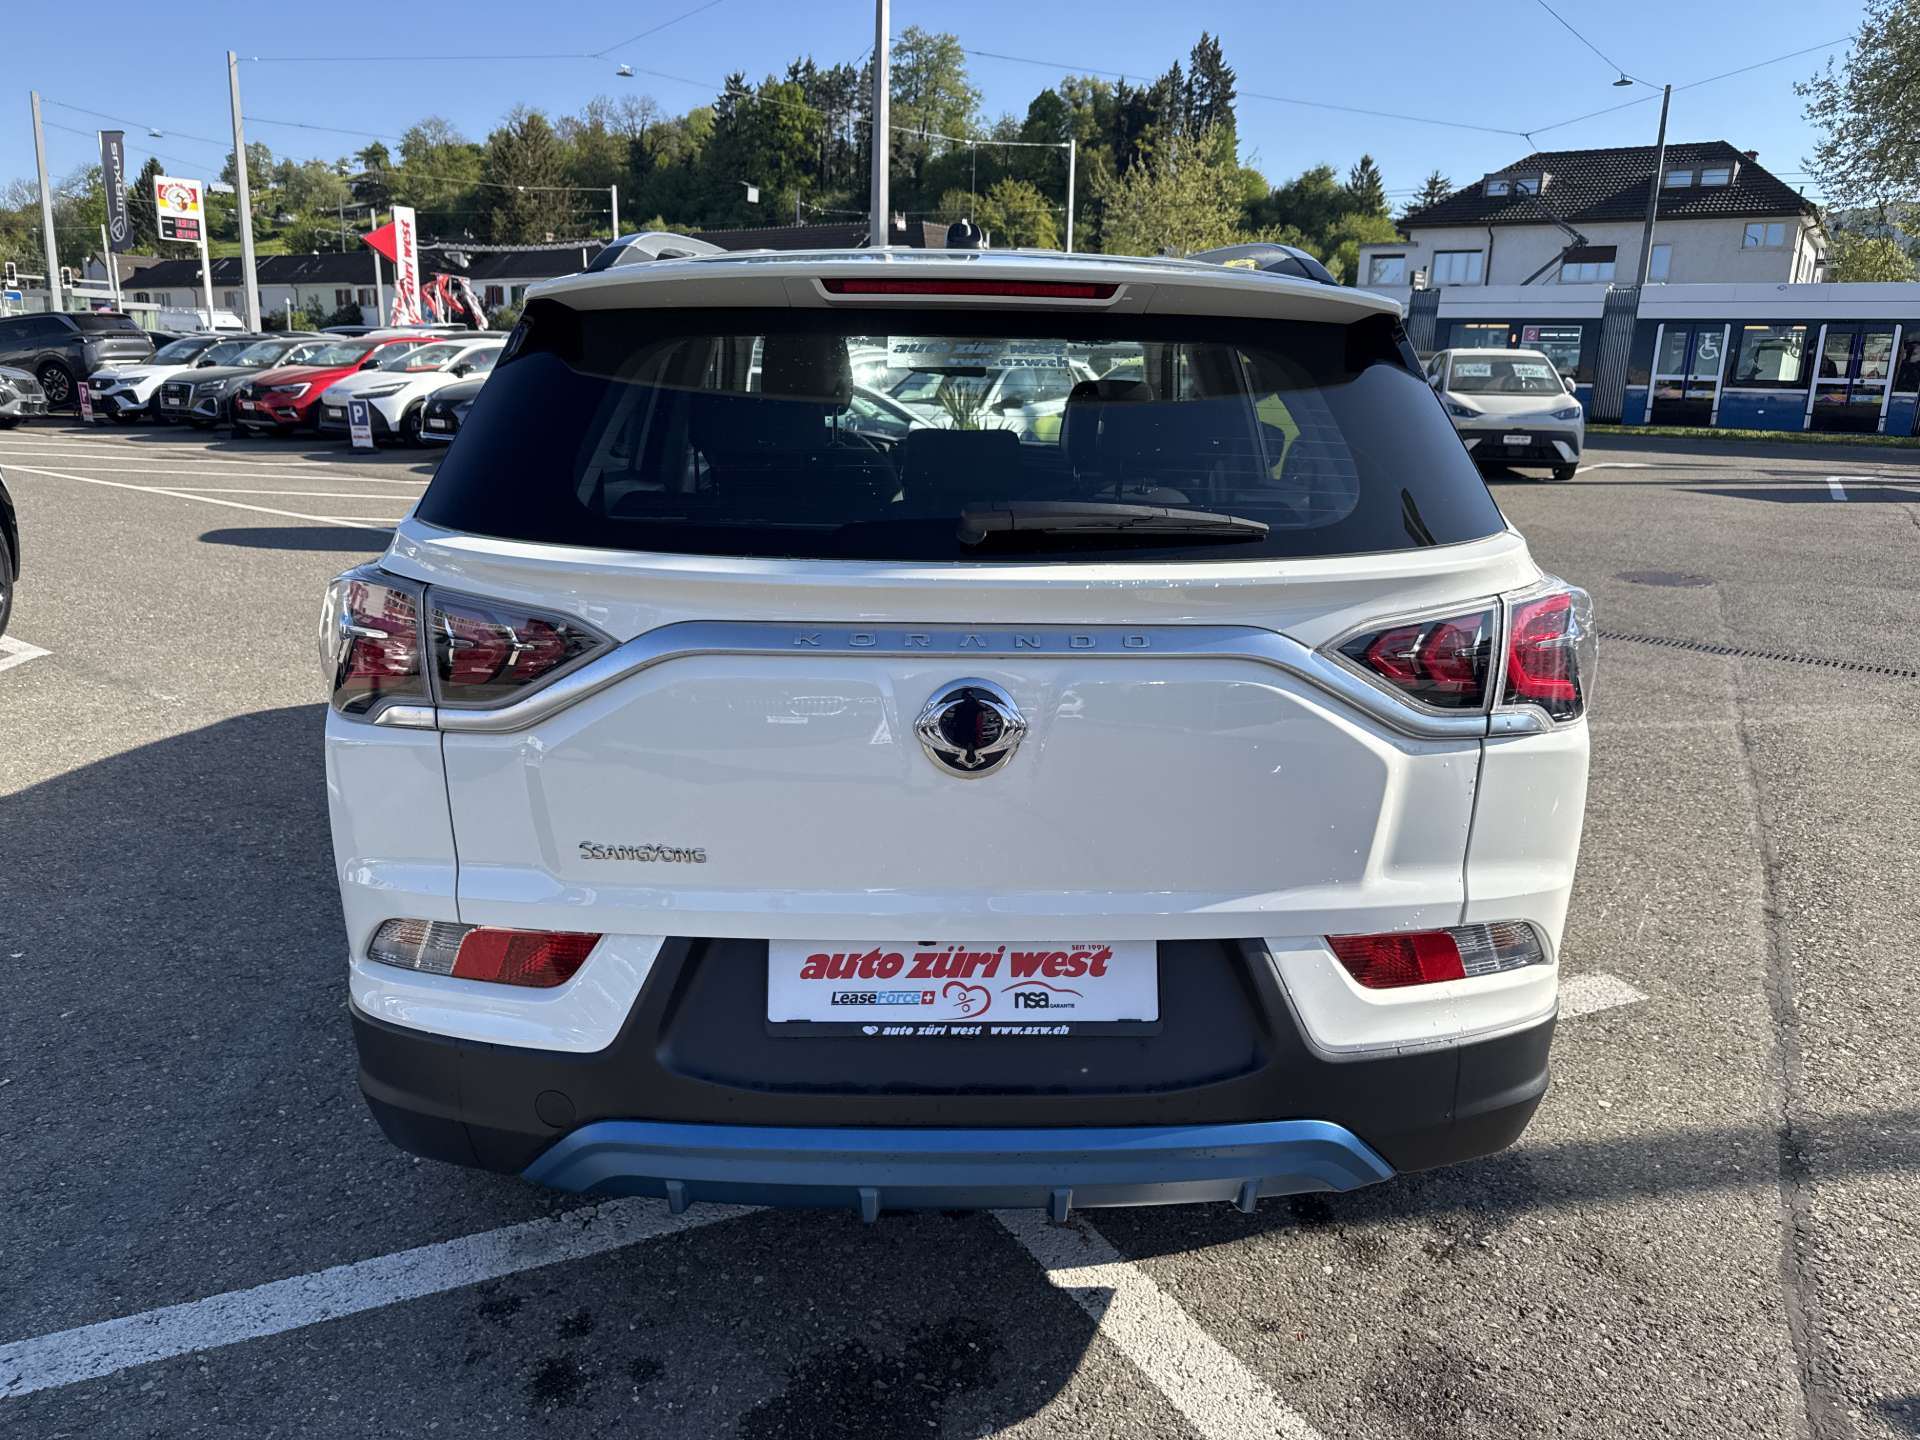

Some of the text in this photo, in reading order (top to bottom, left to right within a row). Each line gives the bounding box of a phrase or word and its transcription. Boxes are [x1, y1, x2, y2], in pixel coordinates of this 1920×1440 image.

[110, 142, 123, 212] MAXUS
[401, 219, 412, 258] west
[353, 405, 363, 423] P
[793, 631, 1151, 649] KORANDO
[799, 945, 1113, 980] auto züri west
[831, 991, 921, 1005] LeaseForce
[1014, 992, 1049, 1009] nsa
[882, 1025, 1071, 1036] auto züri west www.azw.ch
